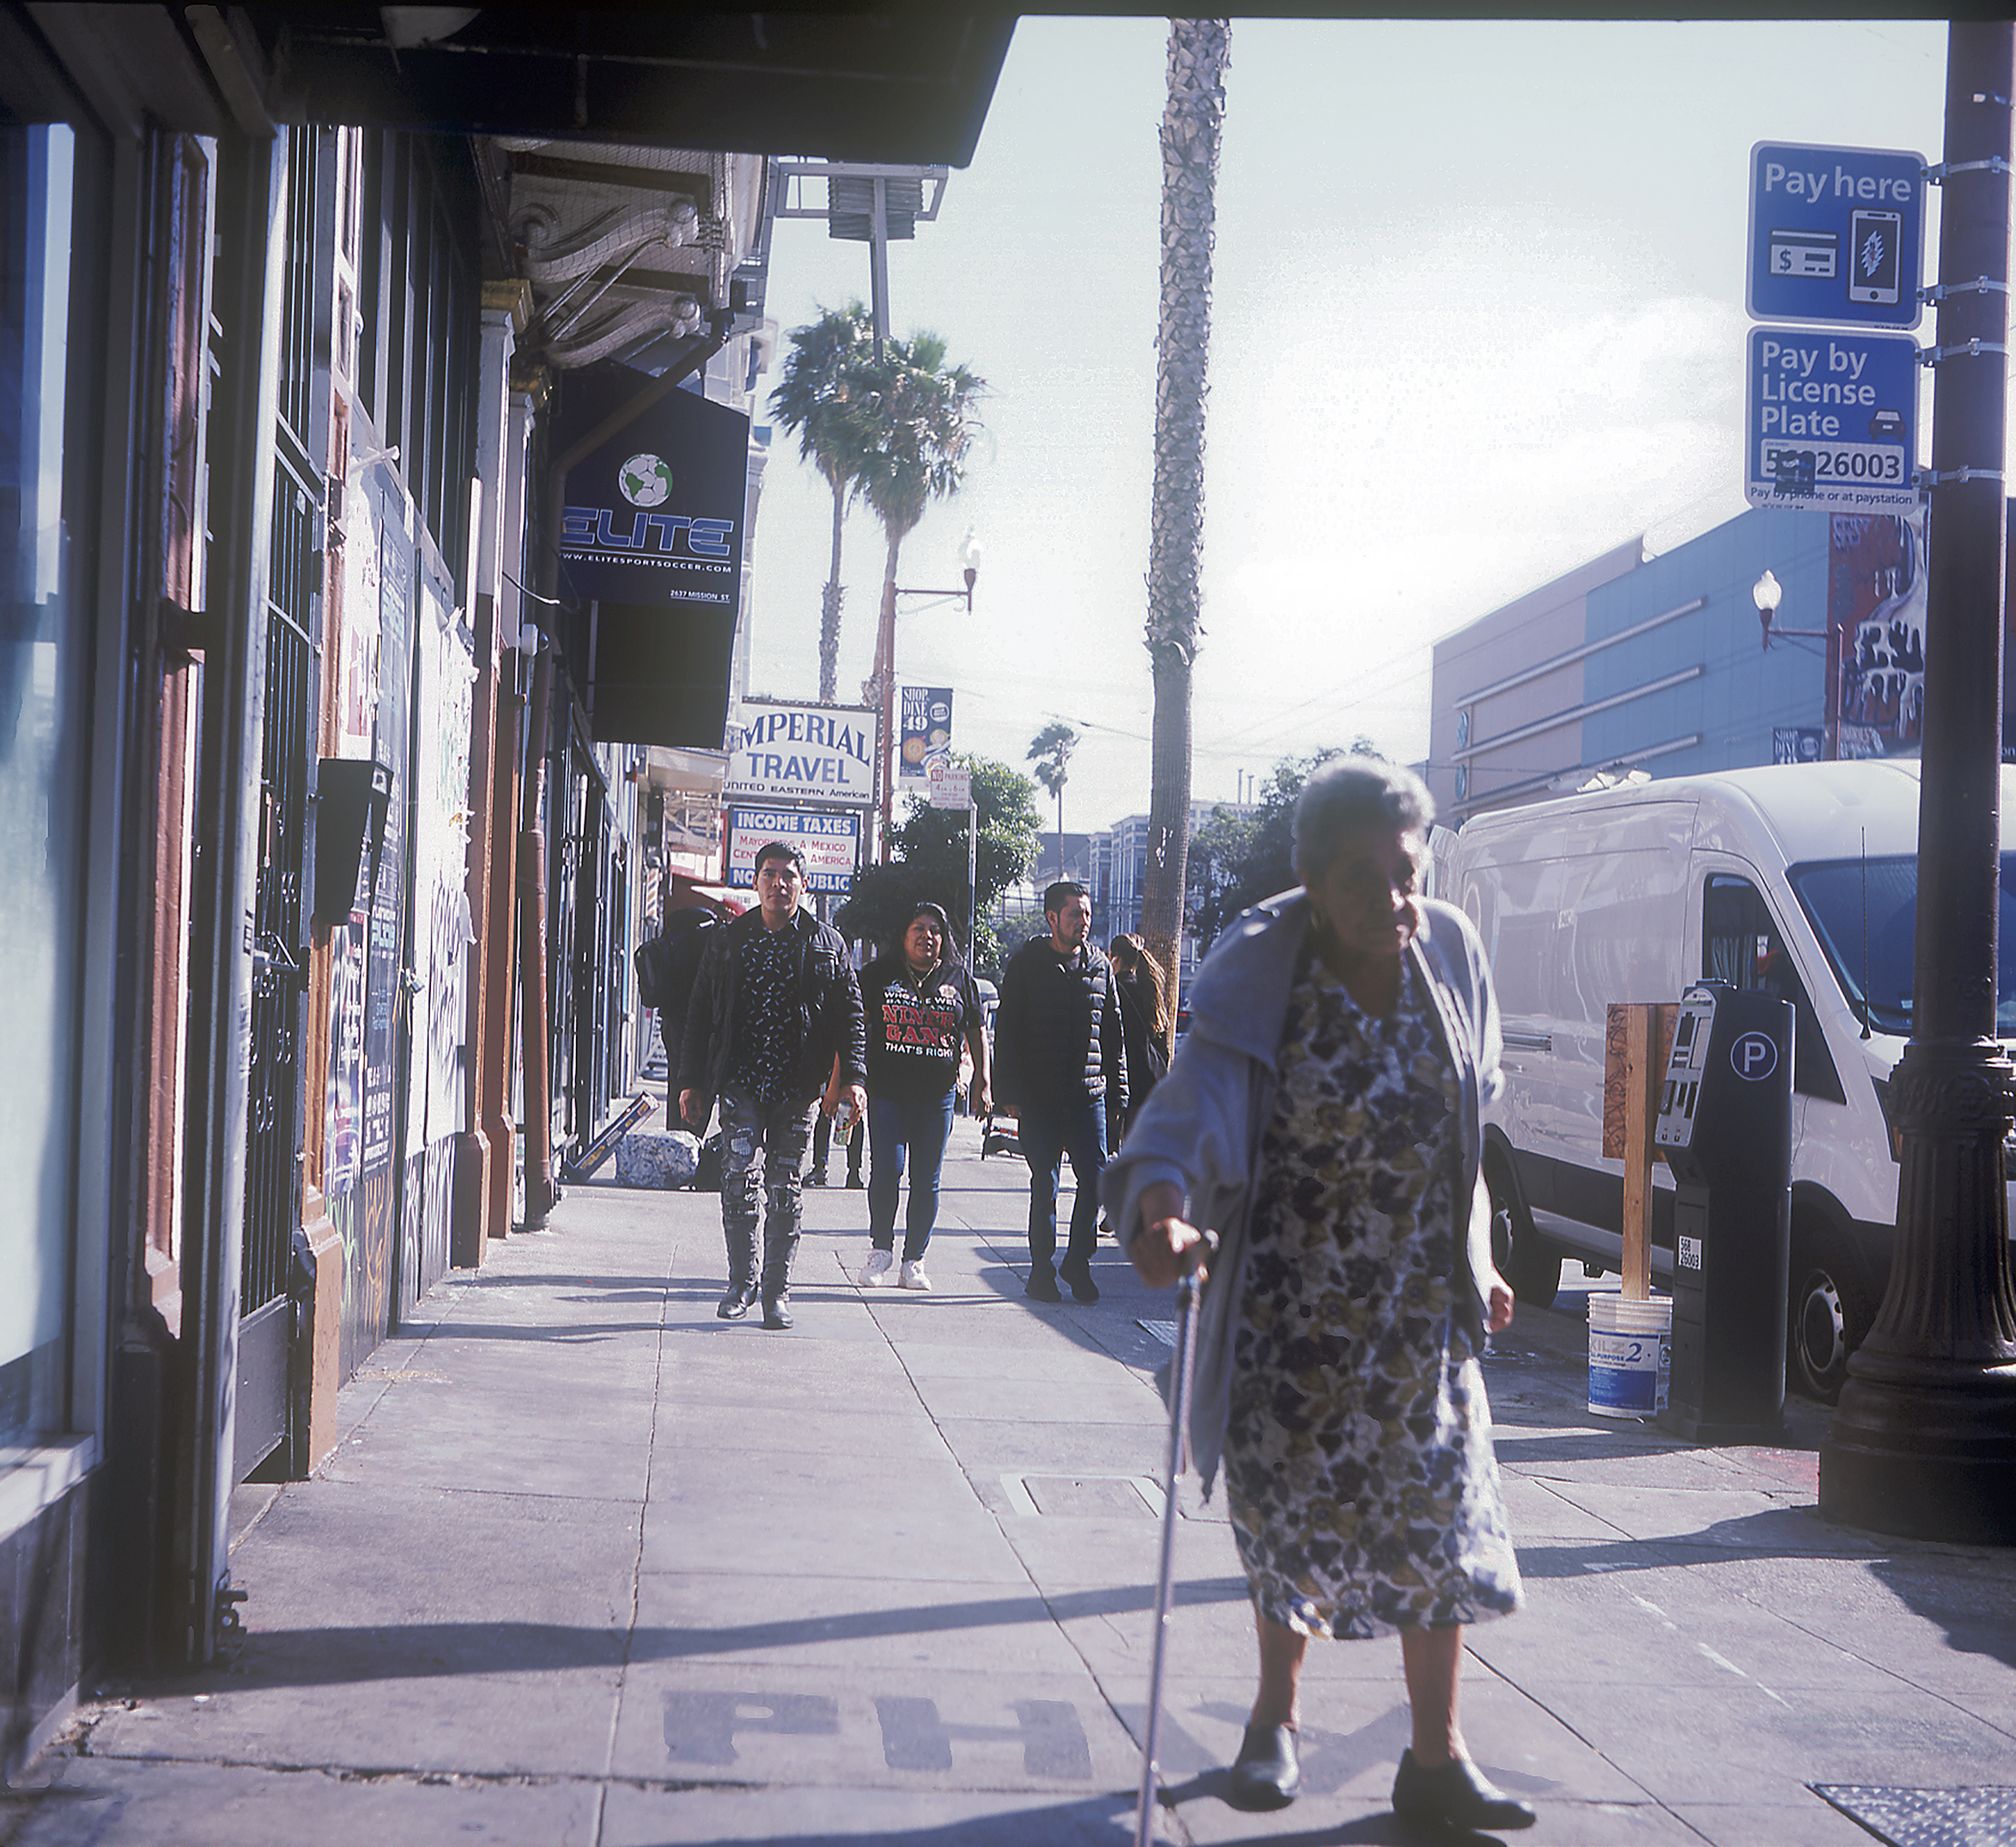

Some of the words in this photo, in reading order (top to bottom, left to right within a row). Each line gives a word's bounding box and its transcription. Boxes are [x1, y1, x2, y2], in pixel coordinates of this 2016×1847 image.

[1764, 162, 1829, 204] Pay
[1834, 166, 1912, 202] here
[1762, 341, 1820, 377] Pay
[1828, 343, 1868, 379] by
[1762, 374, 1877, 406] License
[1761, 407, 1841, 437] Plate
[1766, 448, 1901, 479] 526003
[1750, 487, 1770, 500] Pay
[1856, 493, 1913, 505] paystation
[562, 506, 734, 557] ELITE
[670, 589, 687, 599] 2637
[688, 591, 719, 601] MISSION
[903, 688, 928, 703] SHOP
[903, 702, 927, 717] DINE
[902, 716, 928, 732] 49
[731, 713, 871, 768] MPERIAL
[746, 753, 850, 784] TRAVEL
[930, 770, 944, 781] NO
[945, 773, 968, 783] PARKING
[724, 781, 765, 792] UNITED
[771, 785, 824, 797] EASTERN
[829, 789, 870, 800] American
[737, 812, 799, 831] INCOME
[803, 817, 852, 835] TAXES
[800, 840, 806, 851] A
[811, 841, 847, 852] MEXICO
[810, 853, 852, 866] AMERICA
[804, 874, 851, 892] UBLIC
[885, 1042, 923, 1055] THAT'S
[1744, 1042, 1766, 1072] P
[1681, 1252, 1699, 1268] 26003
[1625, 1342, 1643, 1363] 2
